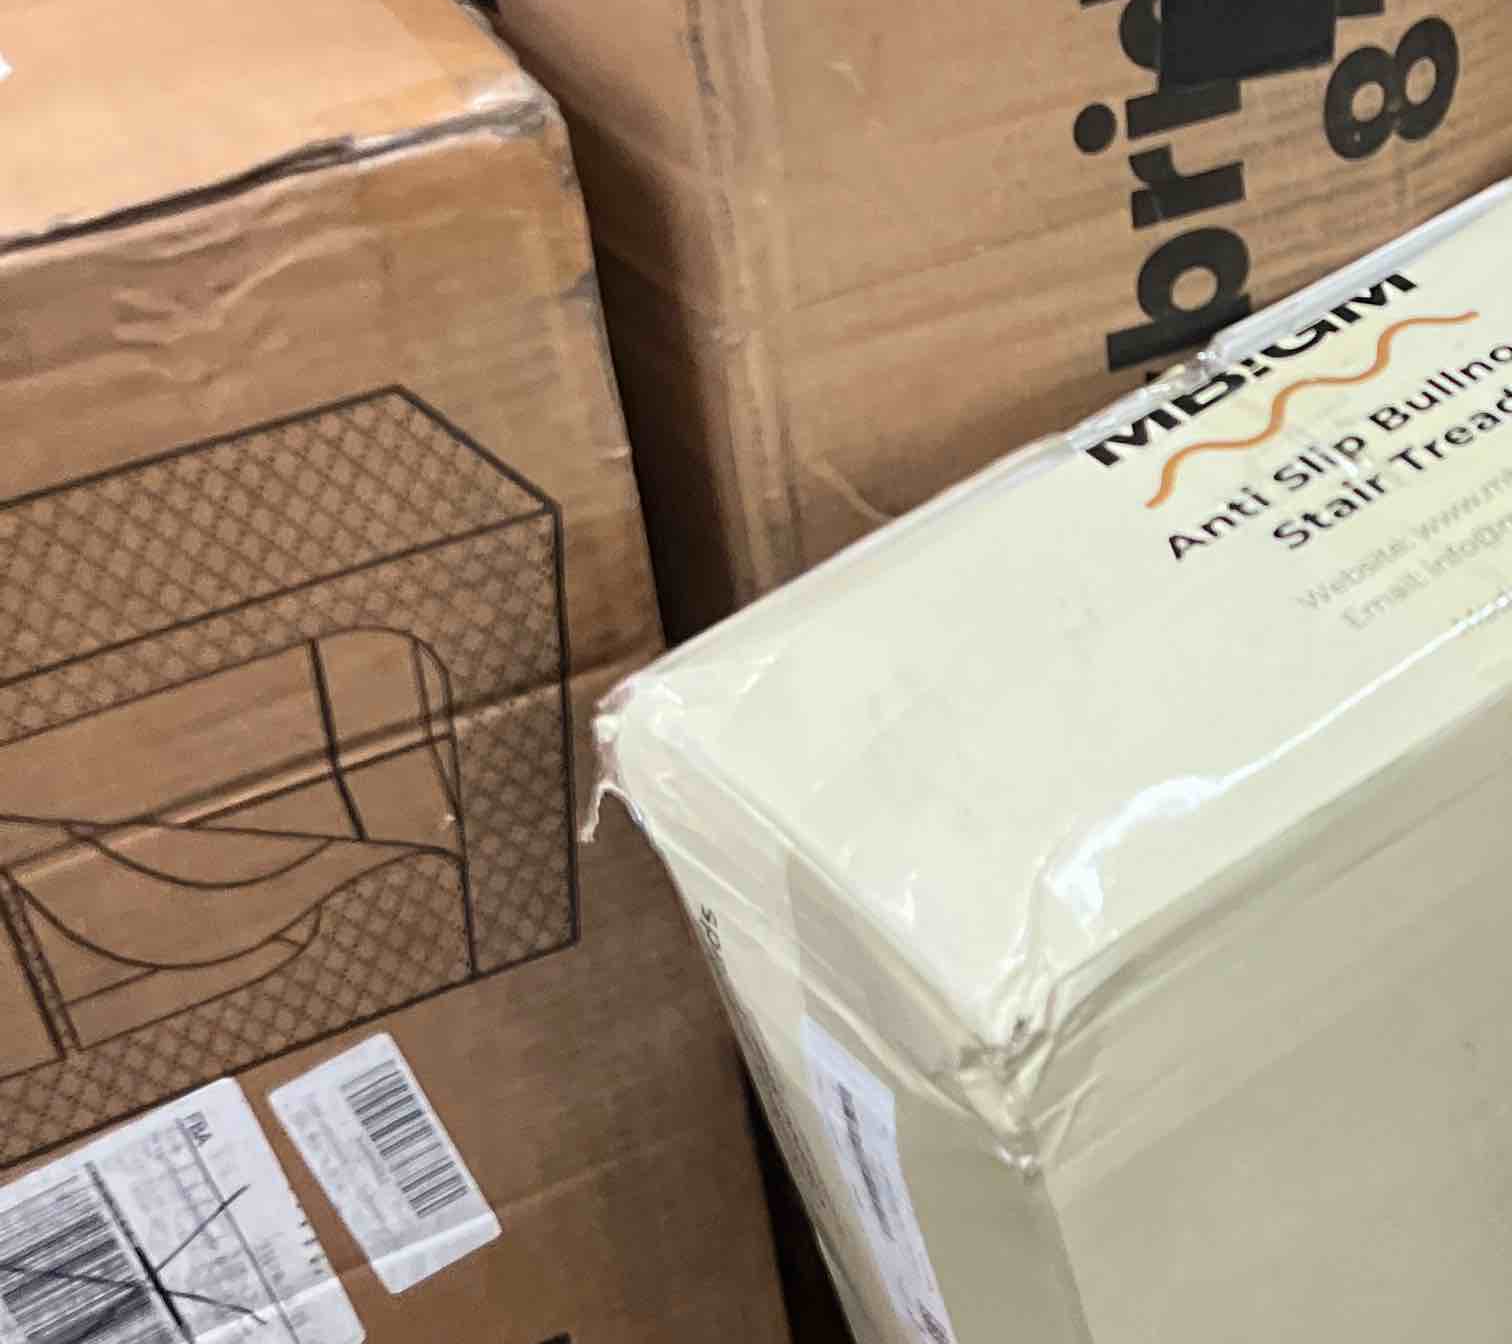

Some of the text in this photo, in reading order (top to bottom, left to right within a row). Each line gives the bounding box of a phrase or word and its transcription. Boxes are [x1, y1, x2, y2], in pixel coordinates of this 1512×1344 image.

[1166, 485, 1270, 561] Anti
[1274, 433, 1365, 491] Slip
[1272, 473, 1386, 549] Stair
